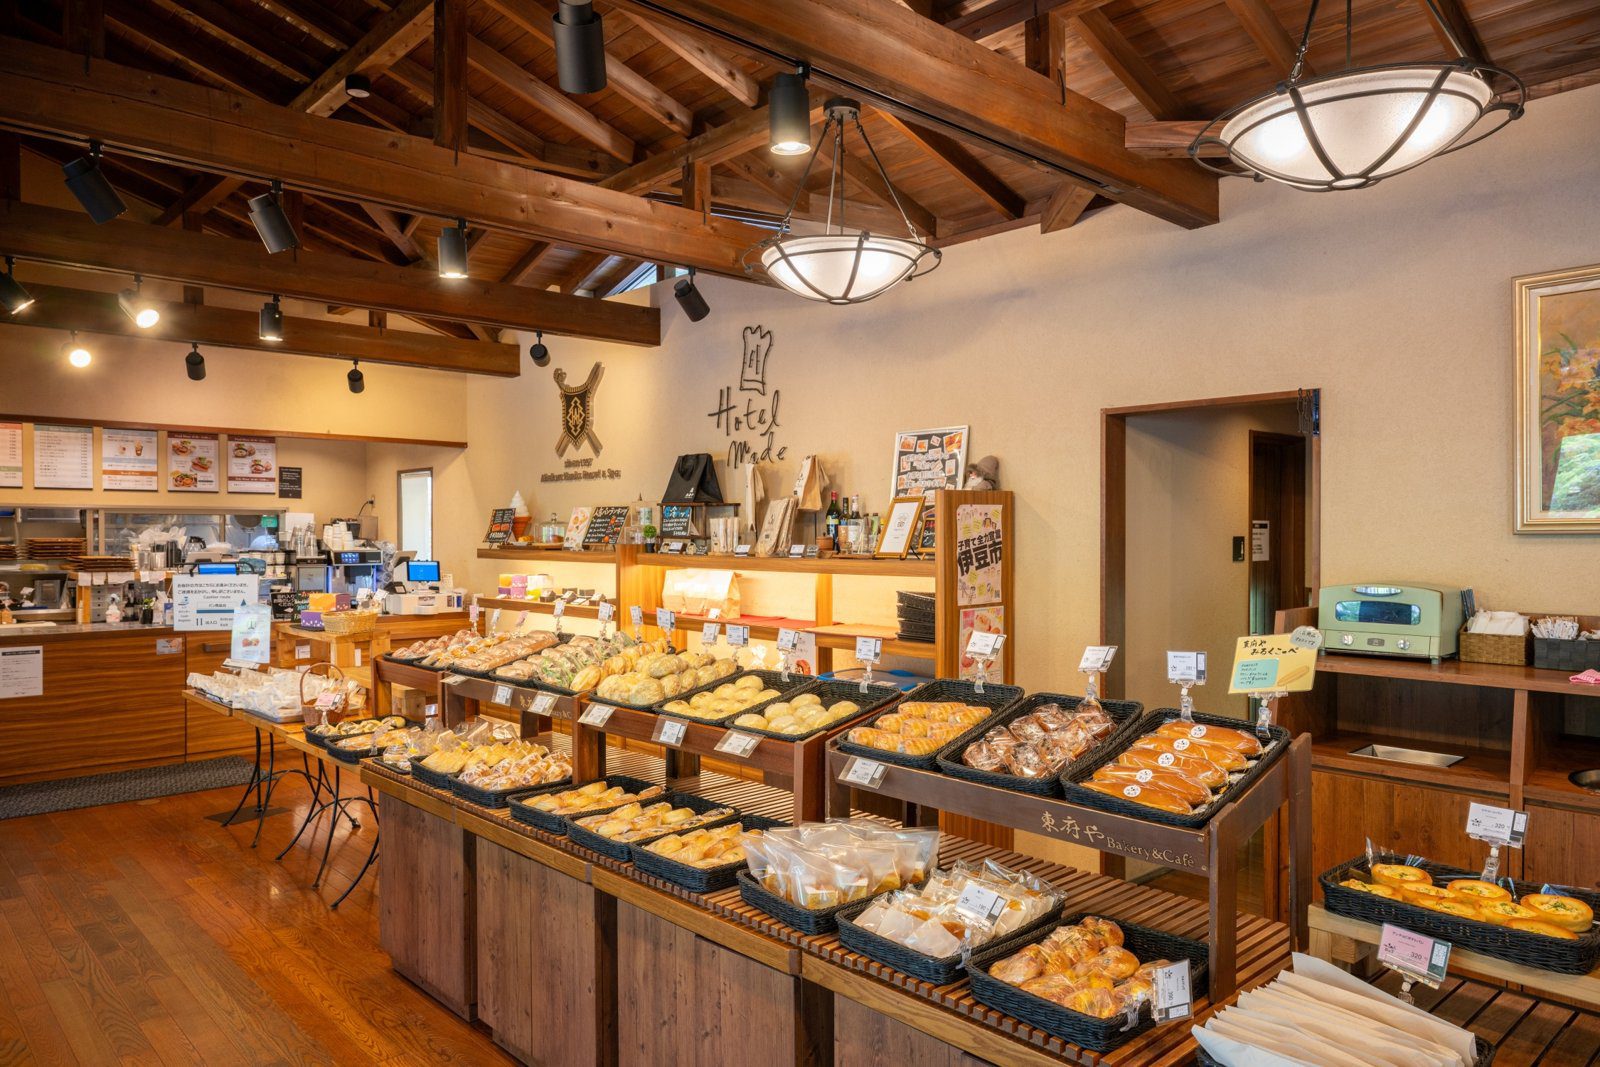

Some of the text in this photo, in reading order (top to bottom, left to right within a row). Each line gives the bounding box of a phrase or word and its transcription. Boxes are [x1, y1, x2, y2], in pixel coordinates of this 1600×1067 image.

[708, 386, 780, 436] Hotel
[957, 541, 1002, 577] 伊豆市
[1041, 810, 1195, 867] 東府や Bakery&Café
